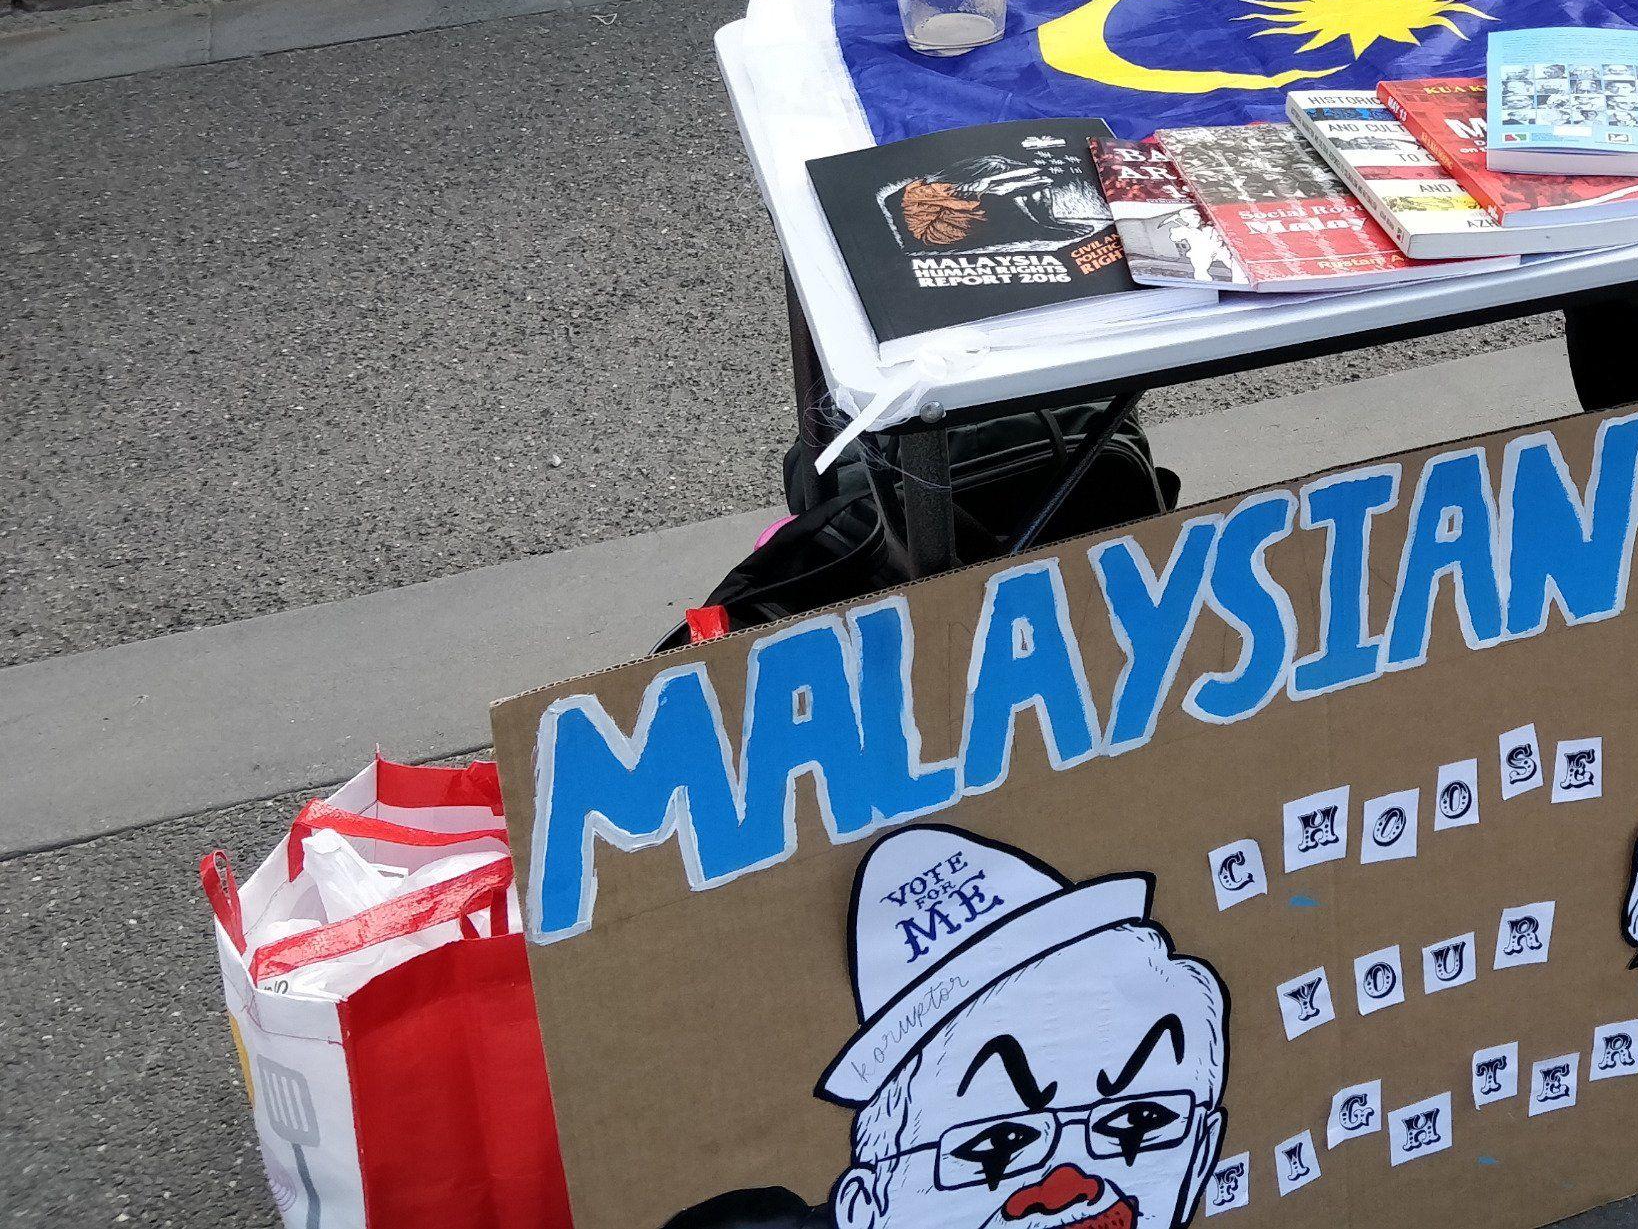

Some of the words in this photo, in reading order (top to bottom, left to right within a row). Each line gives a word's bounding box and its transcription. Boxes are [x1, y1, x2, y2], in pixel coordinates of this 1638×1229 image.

[1423, 85, 1467, 94] KUA
[1328, 123, 1359, 133] AND
[1396, 153, 1419, 163] TO
[1418, 183, 1452, 193] AND
[1238, 207, 1307, 220] Social
[1244, 216, 1367, 235] Malay
[1070, 242, 1103, 259] CIVIL
[912, 255, 1063, 270] MALAYSIA
[914, 266, 992, 278] HUMAN
[1003, 264, 1068, 275] RIGHTS
[918, 274, 1012, 288] REPORT
[1018, 273, 1072, 284] 2016
[1218, 742, 1597, 891] CHOOSE
[880, 850, 969, 908] VOTE
[915, 878, 957, 910] FOR
[896, 869, 1005, 964] ME
[1284, 913, 1544, 1022] YOUR
[853, 973, 970, 1083] koruptor
[1212, 1030, 1636, 1207] FIGHTER
